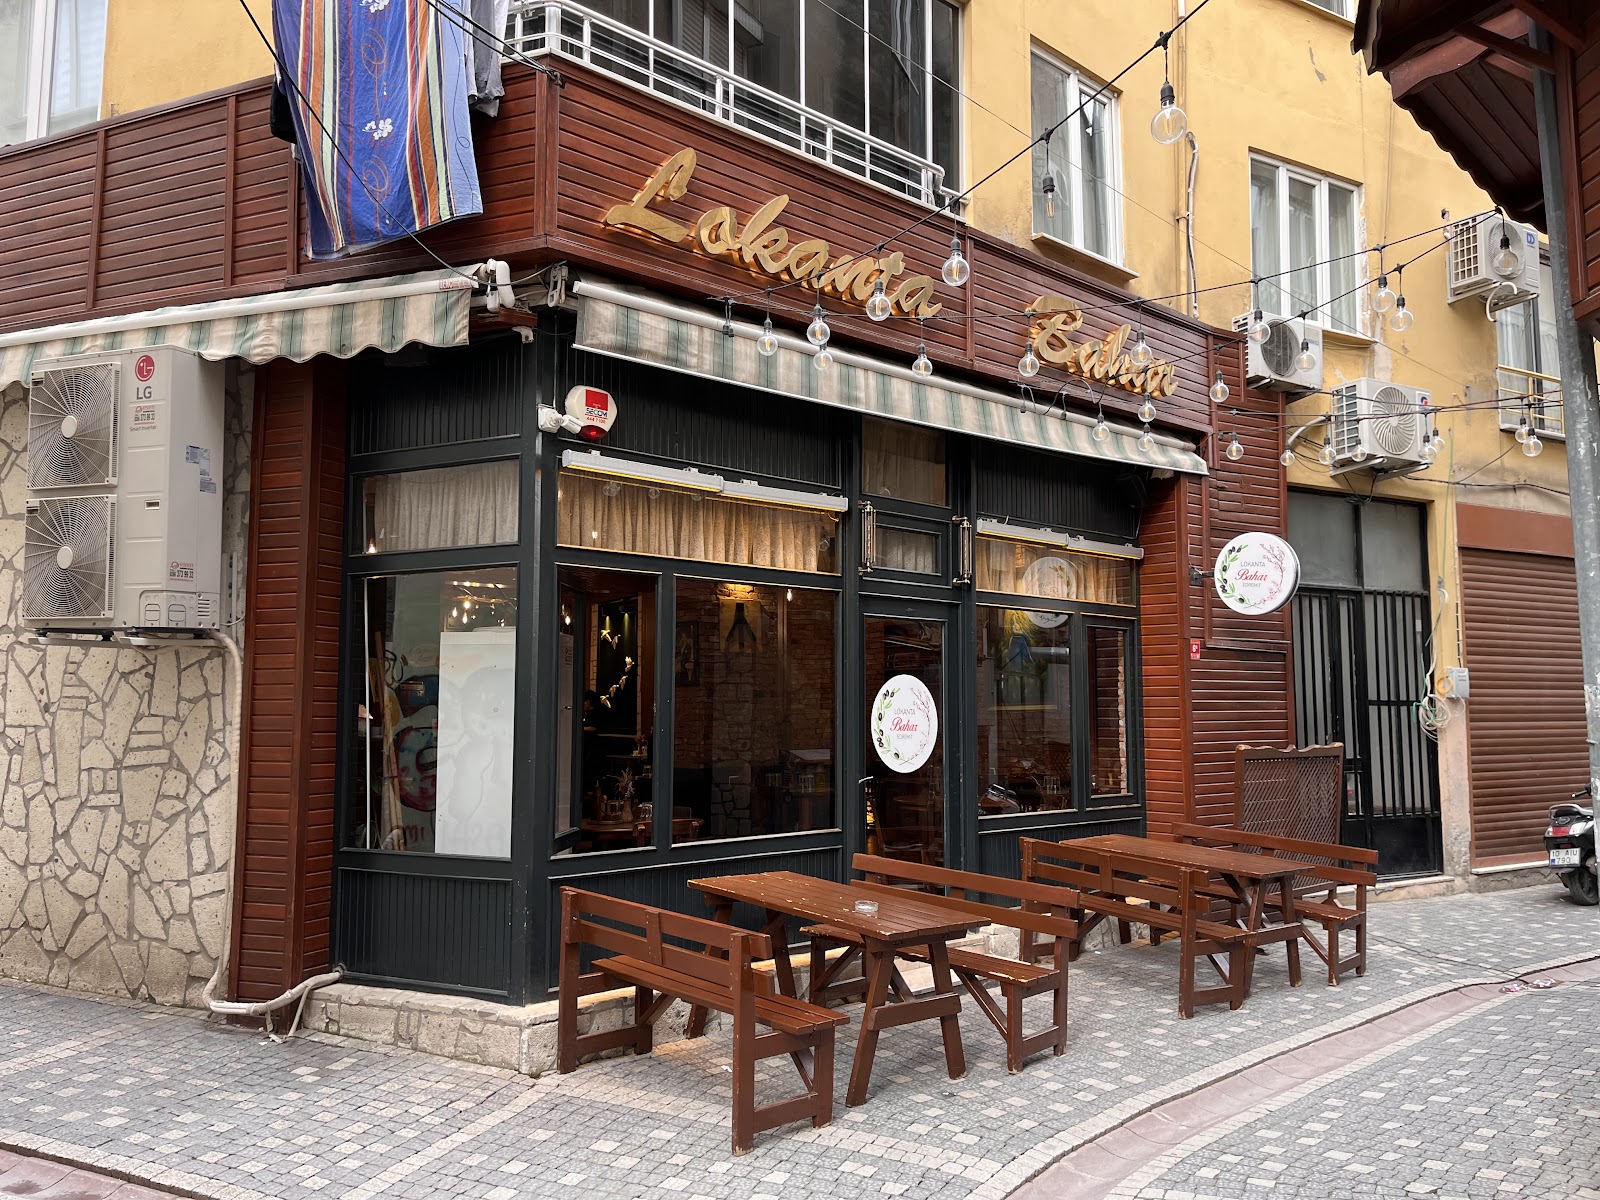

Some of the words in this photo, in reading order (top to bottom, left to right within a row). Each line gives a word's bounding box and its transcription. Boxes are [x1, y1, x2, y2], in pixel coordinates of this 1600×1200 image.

[136, 386, 152, 400] LG
[586, 408, 607, 417] SECOM
[1235, 568, 1268, 581] Bahar
[889, 716, 918, 731] Bahar
